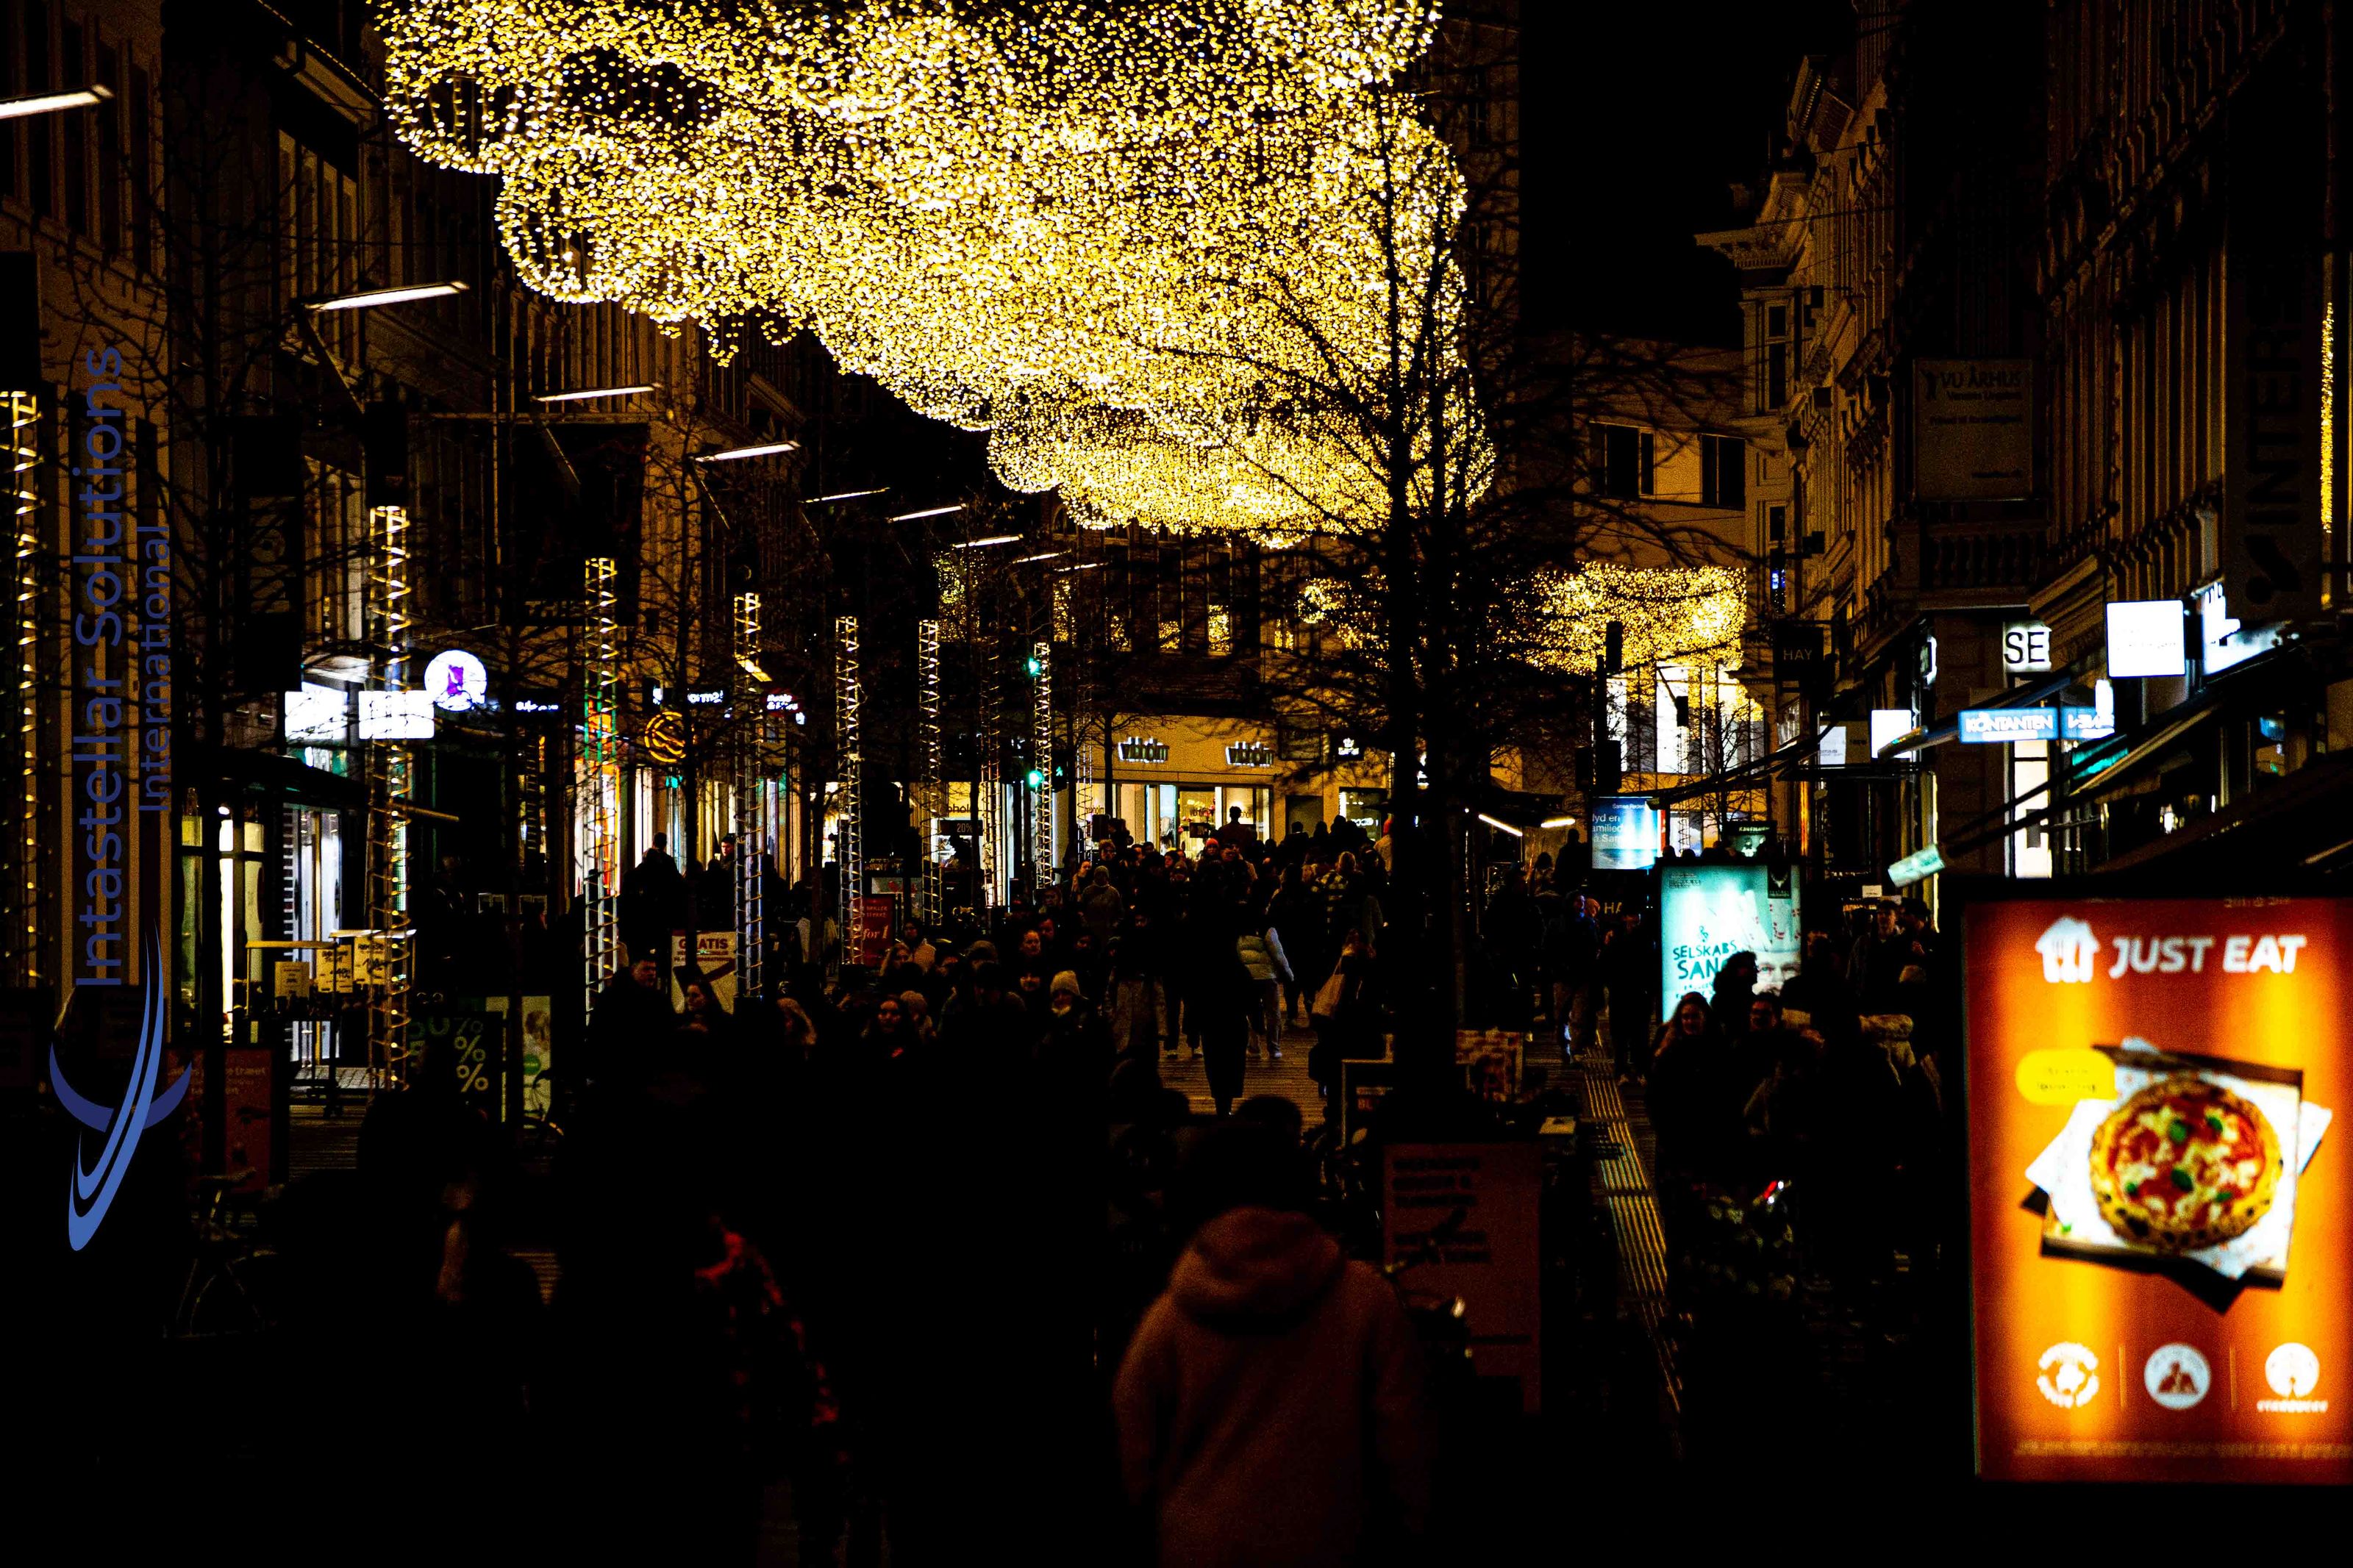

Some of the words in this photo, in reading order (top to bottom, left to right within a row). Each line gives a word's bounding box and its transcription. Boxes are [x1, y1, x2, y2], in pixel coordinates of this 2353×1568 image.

[1783, 648, 1813, 661] HAY
[2004, 631, 2046, 665] SE
[678, 938, 729, 950] GATIS
[1673, 939, 1737, 961] SELSKABS
[2108, 935, 2217, 980] JUST
[2222, 934, 2307, 974] EAT
[1677, 958, 1728, 980] SAN
